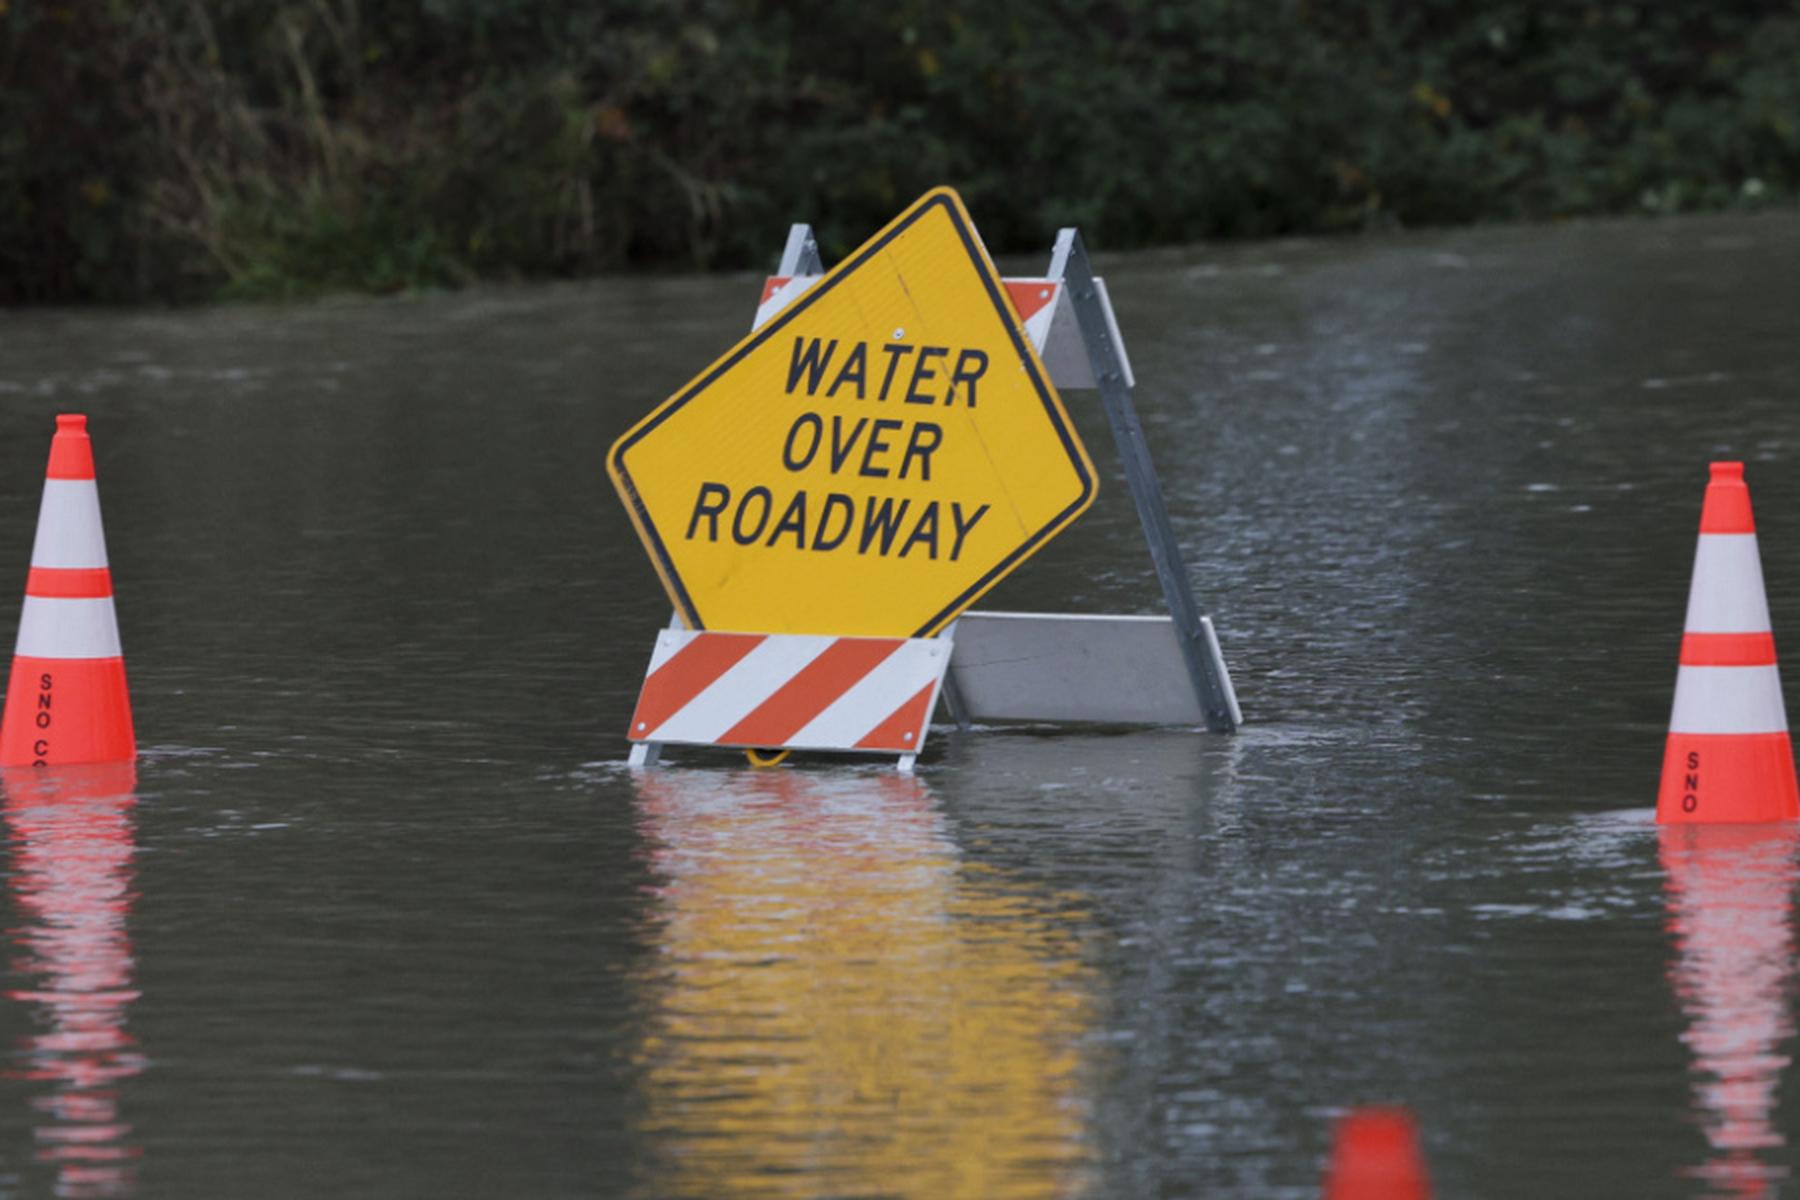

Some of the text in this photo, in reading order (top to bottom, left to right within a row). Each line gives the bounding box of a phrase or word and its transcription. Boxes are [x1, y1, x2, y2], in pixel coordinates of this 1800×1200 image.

[785, 336, 988, 408] WATER
[782, 412, 943, 481] OVER
[685, 482, 991, 561] ROADWAY
[1682, 751, 1699, 813] SNO
